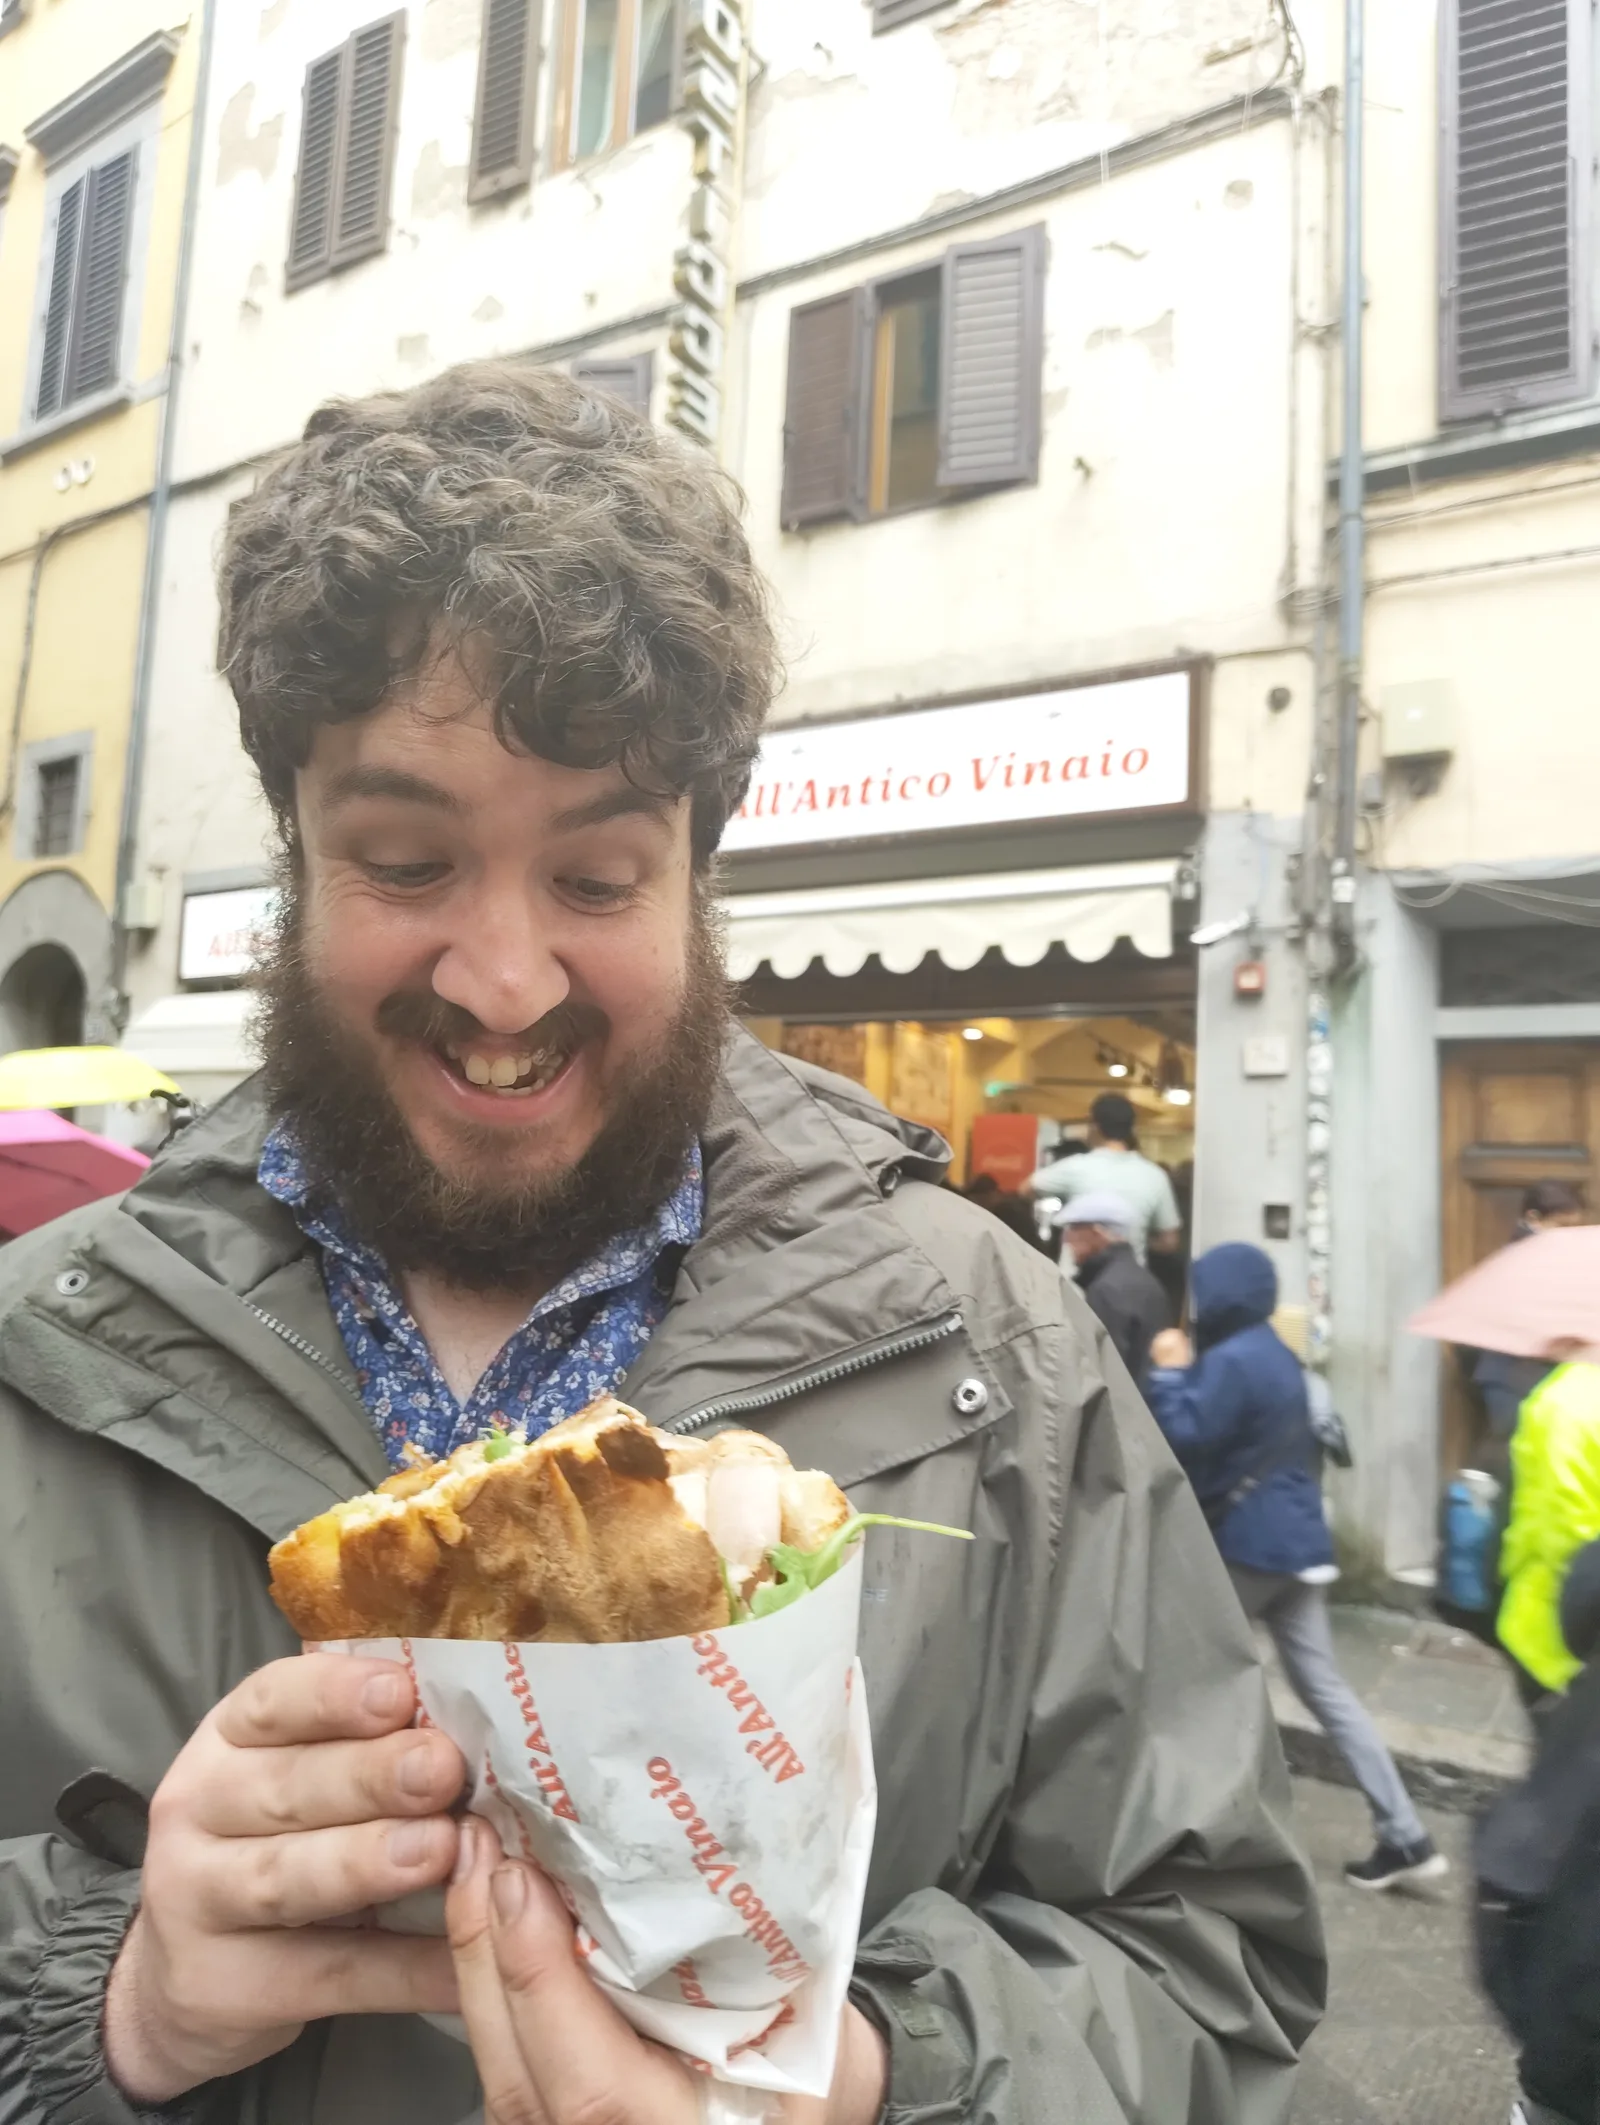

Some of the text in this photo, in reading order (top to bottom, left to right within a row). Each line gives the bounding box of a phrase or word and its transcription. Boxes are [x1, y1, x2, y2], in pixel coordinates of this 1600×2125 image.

[970, 739, 1150, 792] Vinaio
[504, 1641, 580, 1824] All'Antic
[691, 1634, 805, 1784] All'Antic
[647, 1756, 738, 1894] Vinaio
[728, 1882, 812, 1983] ll'Antico
